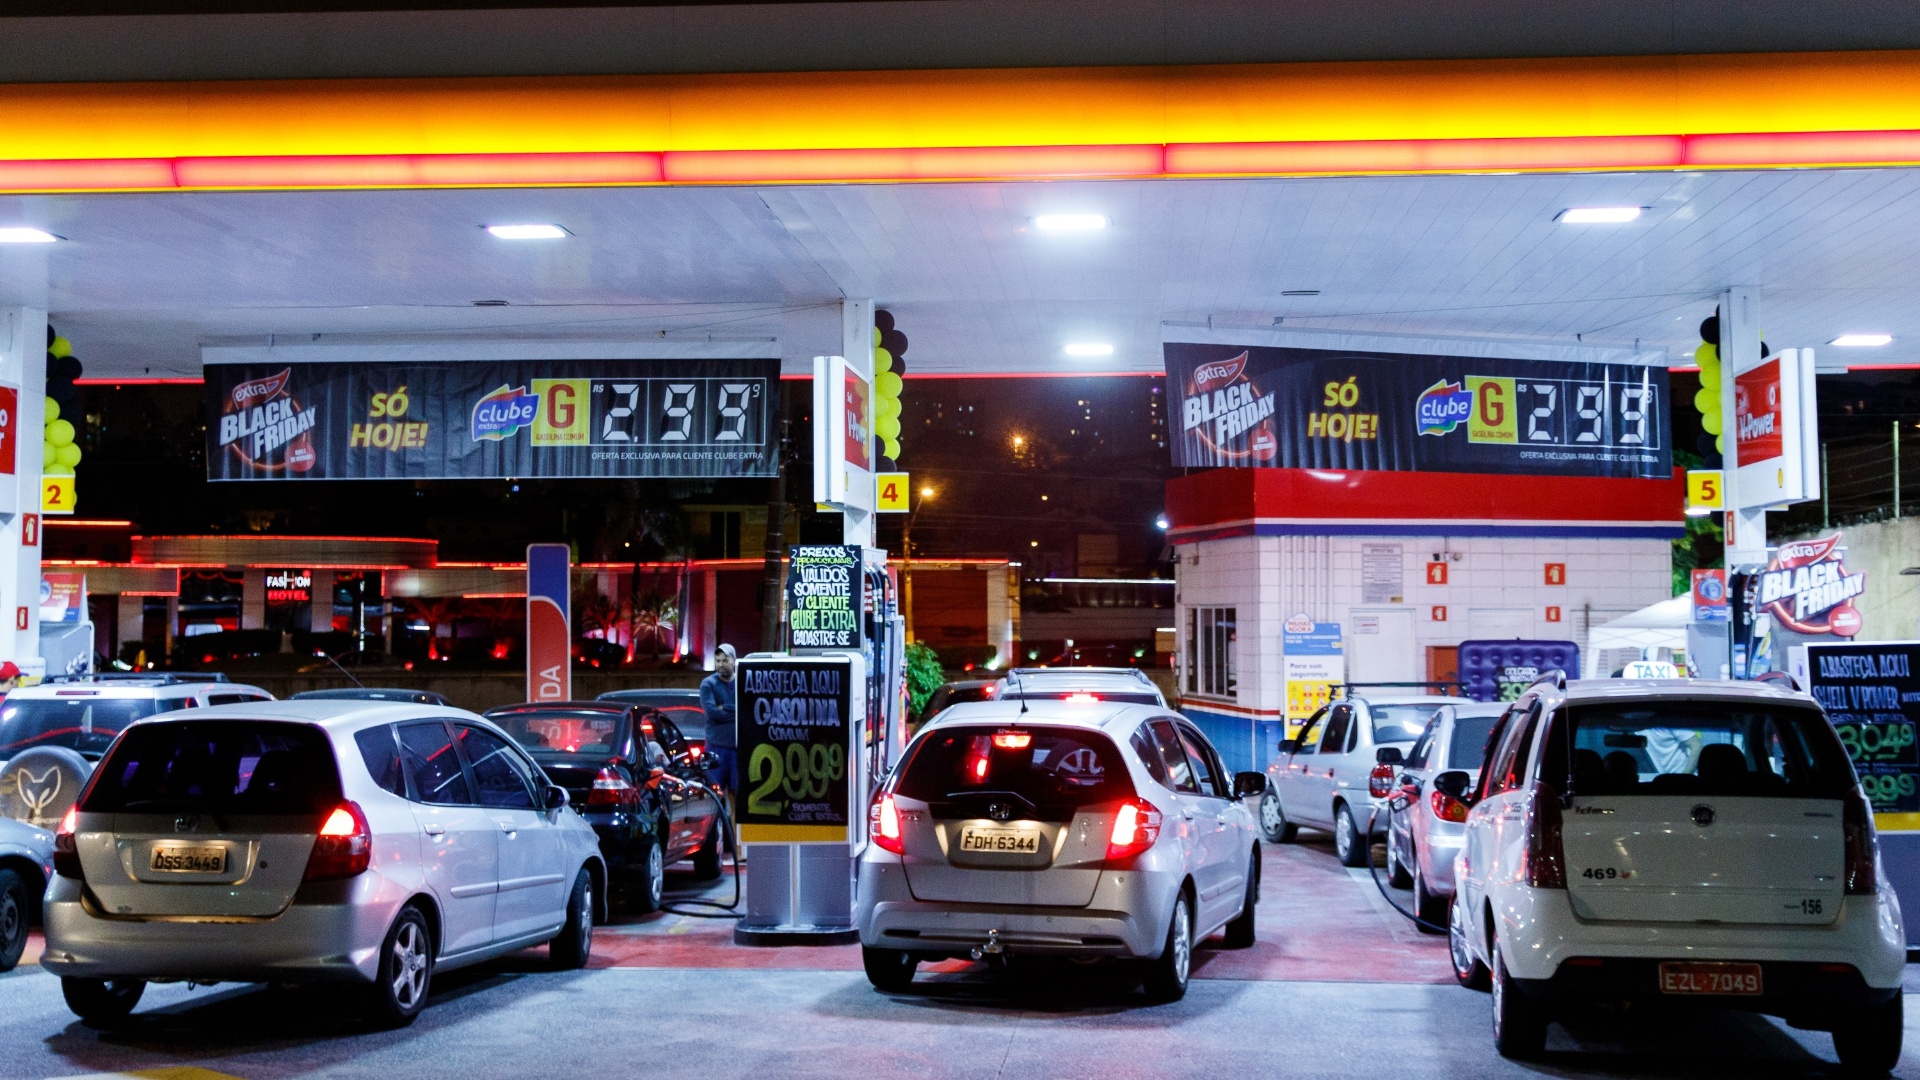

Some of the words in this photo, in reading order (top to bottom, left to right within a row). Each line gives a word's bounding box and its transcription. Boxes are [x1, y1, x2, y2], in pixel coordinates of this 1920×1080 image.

[1196, 364, 1227, 384] extra
[235, 382, 268, 402] extra
[369, 386, 409, 417] SÓ
[1324, 376, 1359, 407] SÓ
[479, 402, 533, 422] clube
[546, 383, 575, 429] G
[1185, 382, 1254, 431] BLACK
[1421, 396, 1469, 417] clube
[1479, 381, 1505, 427] G
[219, 398, 294, 446] BLACK
[1217, 390, 1275, 447] FRIDAY
[1307, 412, 1379, 443] HOJE!
[1739, 412, 1775, 441] V-Power
[253, 405, 316, 460] FRIDAY
[350, 423, 429, 452] HOJE!
[535, 432, 562, 441] GASOLINA
[563, 432, 584, 441] COMUM
[592, 452, 620, 460] OFERTA
[621, 452, 660, 460] EXCLUSIVA
[661, 452, 681, 460] PARA
[683, 452, 713, 460] CLIENTE
[714, 452, 738, 460] CLUBE
[739, 452, 763, 460] EXTRA
[1520, 451, 1543, 459] OFERTA
[1544, 452, 1577, 460] EXCLUSIVA
[47, 485, 61, 504] 2
[882, 483, 898, 502] 4
[1701, 480, 1716, 500] 5
[1780, 545, 1814, 562] extra
[266, 570, 311, 590] FASHION
[794, 583, 851, 596] SOMENTE
[1761, 561, 1840, 604] BLACK
[267, 590, 309, 600] MOTEL
[806, 596, 850, 610] CLIENTE
[1795, 573, 1864, 621] FRIDAY
[791, 609, 818, 630] CLUBE
[821, 610, 857, 632] EXTRA
[1633, 665, 1670, 678] TAXI
[1819, 655, 1879, 679] ABASTEÇA
[1879, 654, 1910, 677] AQUI
[744, 669, 808, 696] ABASTEÇA
[811, 670, 840, 695] AQUI
[1813, 686, 1849, 709] SHELL
[1861, 686, 1901, 710] POWER
[754, 697, 840, 727] GASOLINA
[768, 726, 810, 741] COMUM
[1583, 868, 1617, 879] 469
[1802, 899, 1822, 915] 156
